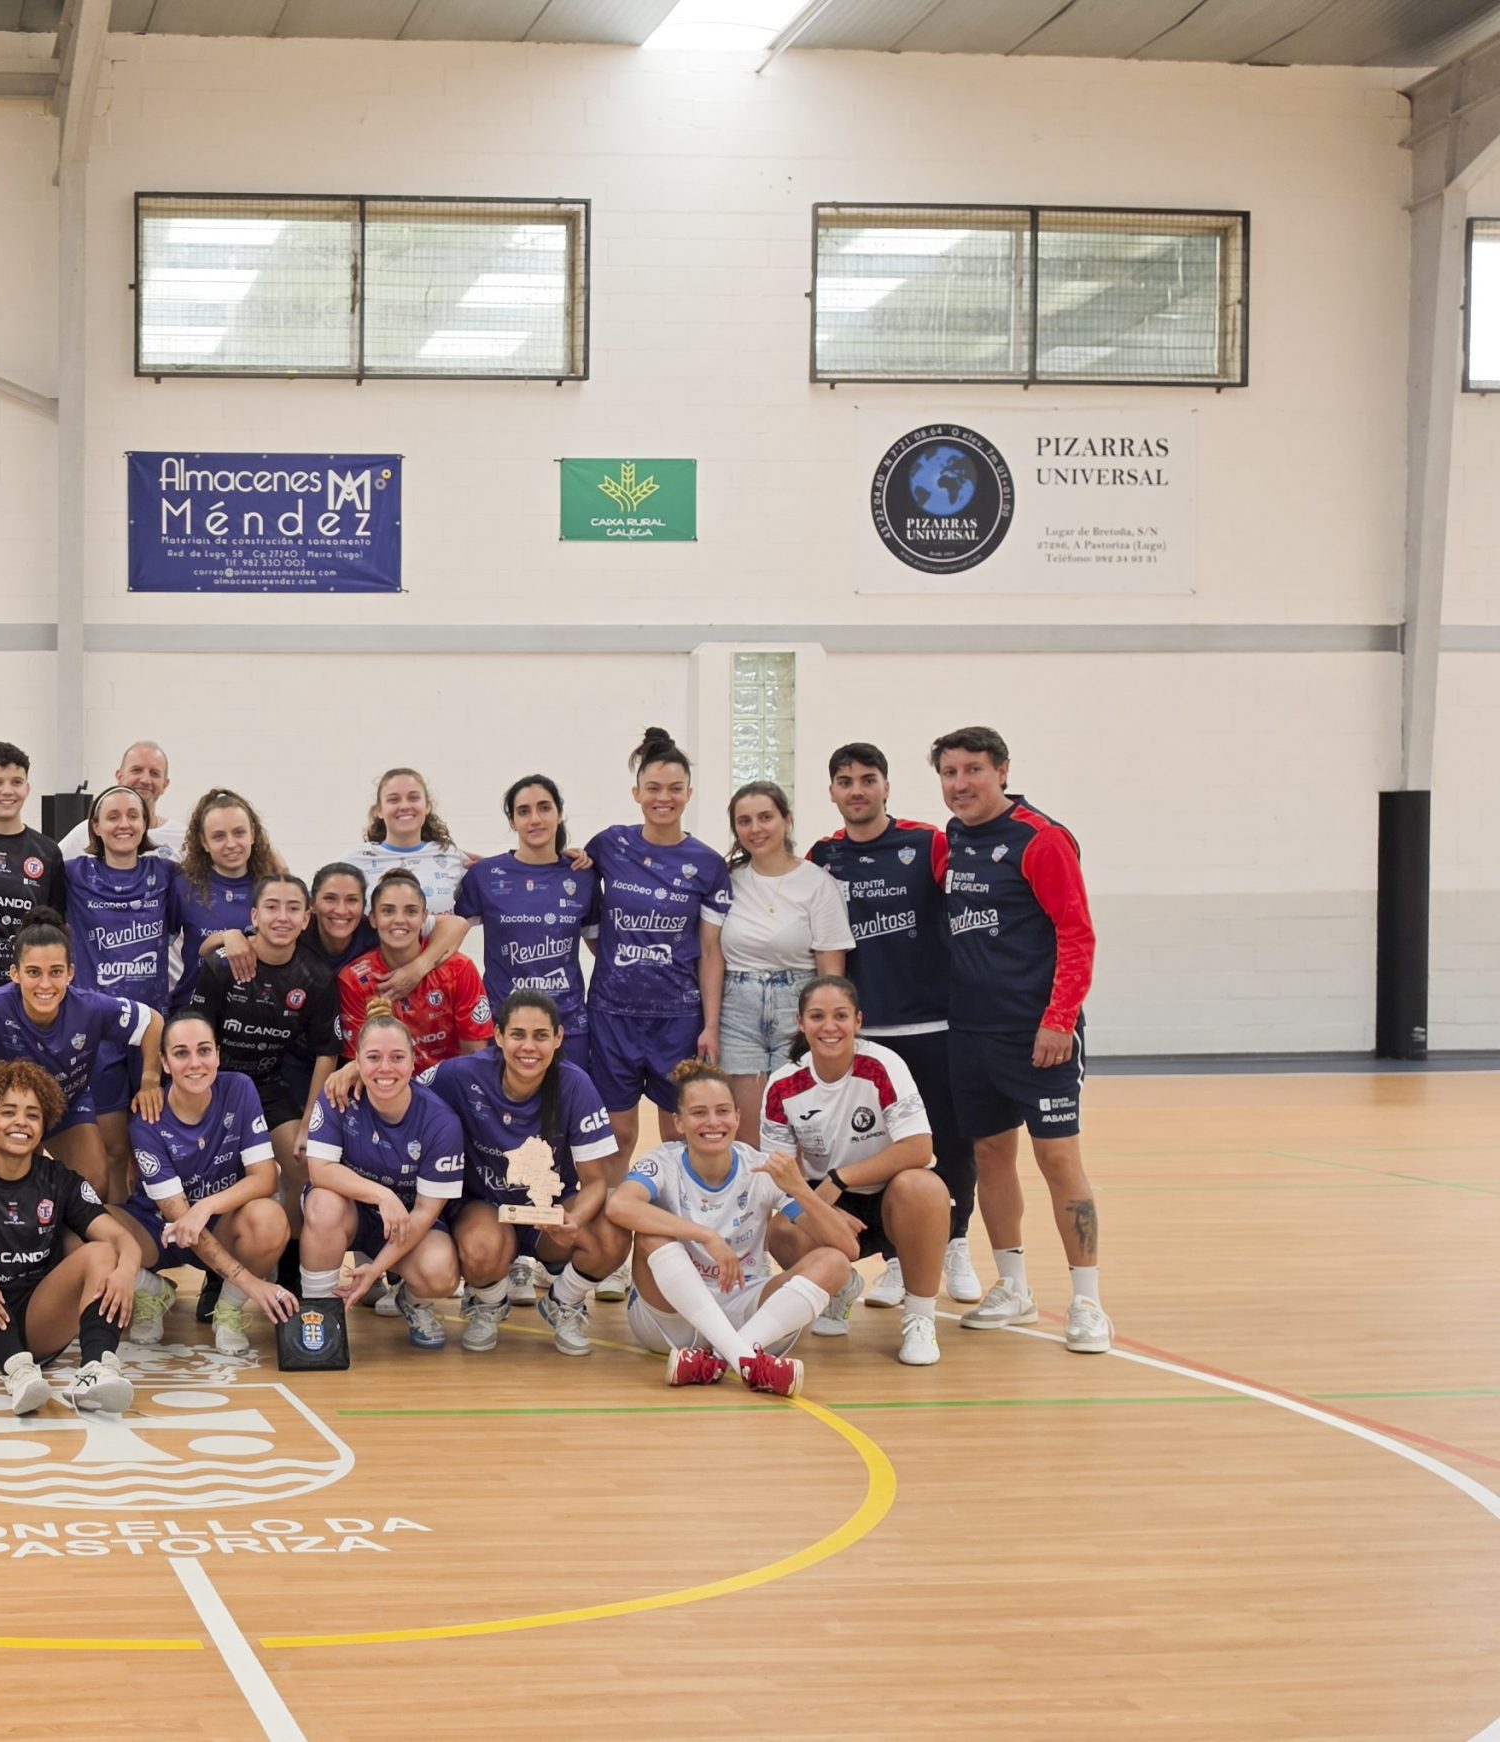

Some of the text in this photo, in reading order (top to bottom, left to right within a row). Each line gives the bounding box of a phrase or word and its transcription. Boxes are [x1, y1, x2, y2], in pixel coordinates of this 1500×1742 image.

[1036, 437, 1170, 458] PIZARRAS
[159, 457, 322, 492] Almacenes
[1036, 468, 1170, 486] UNIVERSAL
[161, 498, 371, 536] Méndez
[590, 518, 666, 526] CAIXA RURAL
[906, 518, 978, 529] PIZARRAS
[606, 528, 654, 537] GALEGA
[906, 529, 979, 540] UNIVERSAL
[1045, 526, 1075, 538] Lugar
[1078, 526, 1090, 536] de
[161, 536, 210, 545] Materiais
[214, 536, 228, 545] de
[298, 538, 303, 546] e
[1084, 540, 1130, 550] Pastoriza
[1132, 540, 1167, 552] (Lugo)
[190, 550, 202, 558] de
[335, 550, 364, 560] (Lugo)
[242, 559, 258, 567] 982
[284, 559, 306, 567] 002
[953, 872, 976, 882] XUNTA
[612, 880, 690, 902] Xacobeo 2027
[852, 879, 886, 890] XUNTA
[952, 881, 990, 894] DE GALICIA
[715, 890, 733, 904] GL
[852, 886, 908, 898] DE GALICIA
[87, 900, 128, 910] Xacobeo
[500, 914, 577, 924] Xacobeo 2027
[614, 908, 688, 932] Revoltosa
[851, 910, 916, 937] evoltosa
[95, 920, 164, 951] Revoltosa
[509, 935, 574, 966] Revoltosa
[98, 961, 157, 976] SOCITRANSA
[512, 976, 570, 990] SOCITRANSA
[244, 1025, 291, 1038] CANDO
[222, 1038, 256, 1049] Xacobeo
[213, 1152, 234, 1165] 2027
[0, 1247, 50, 1263] CANDO
[323, 1516, 434, 1534] DA
